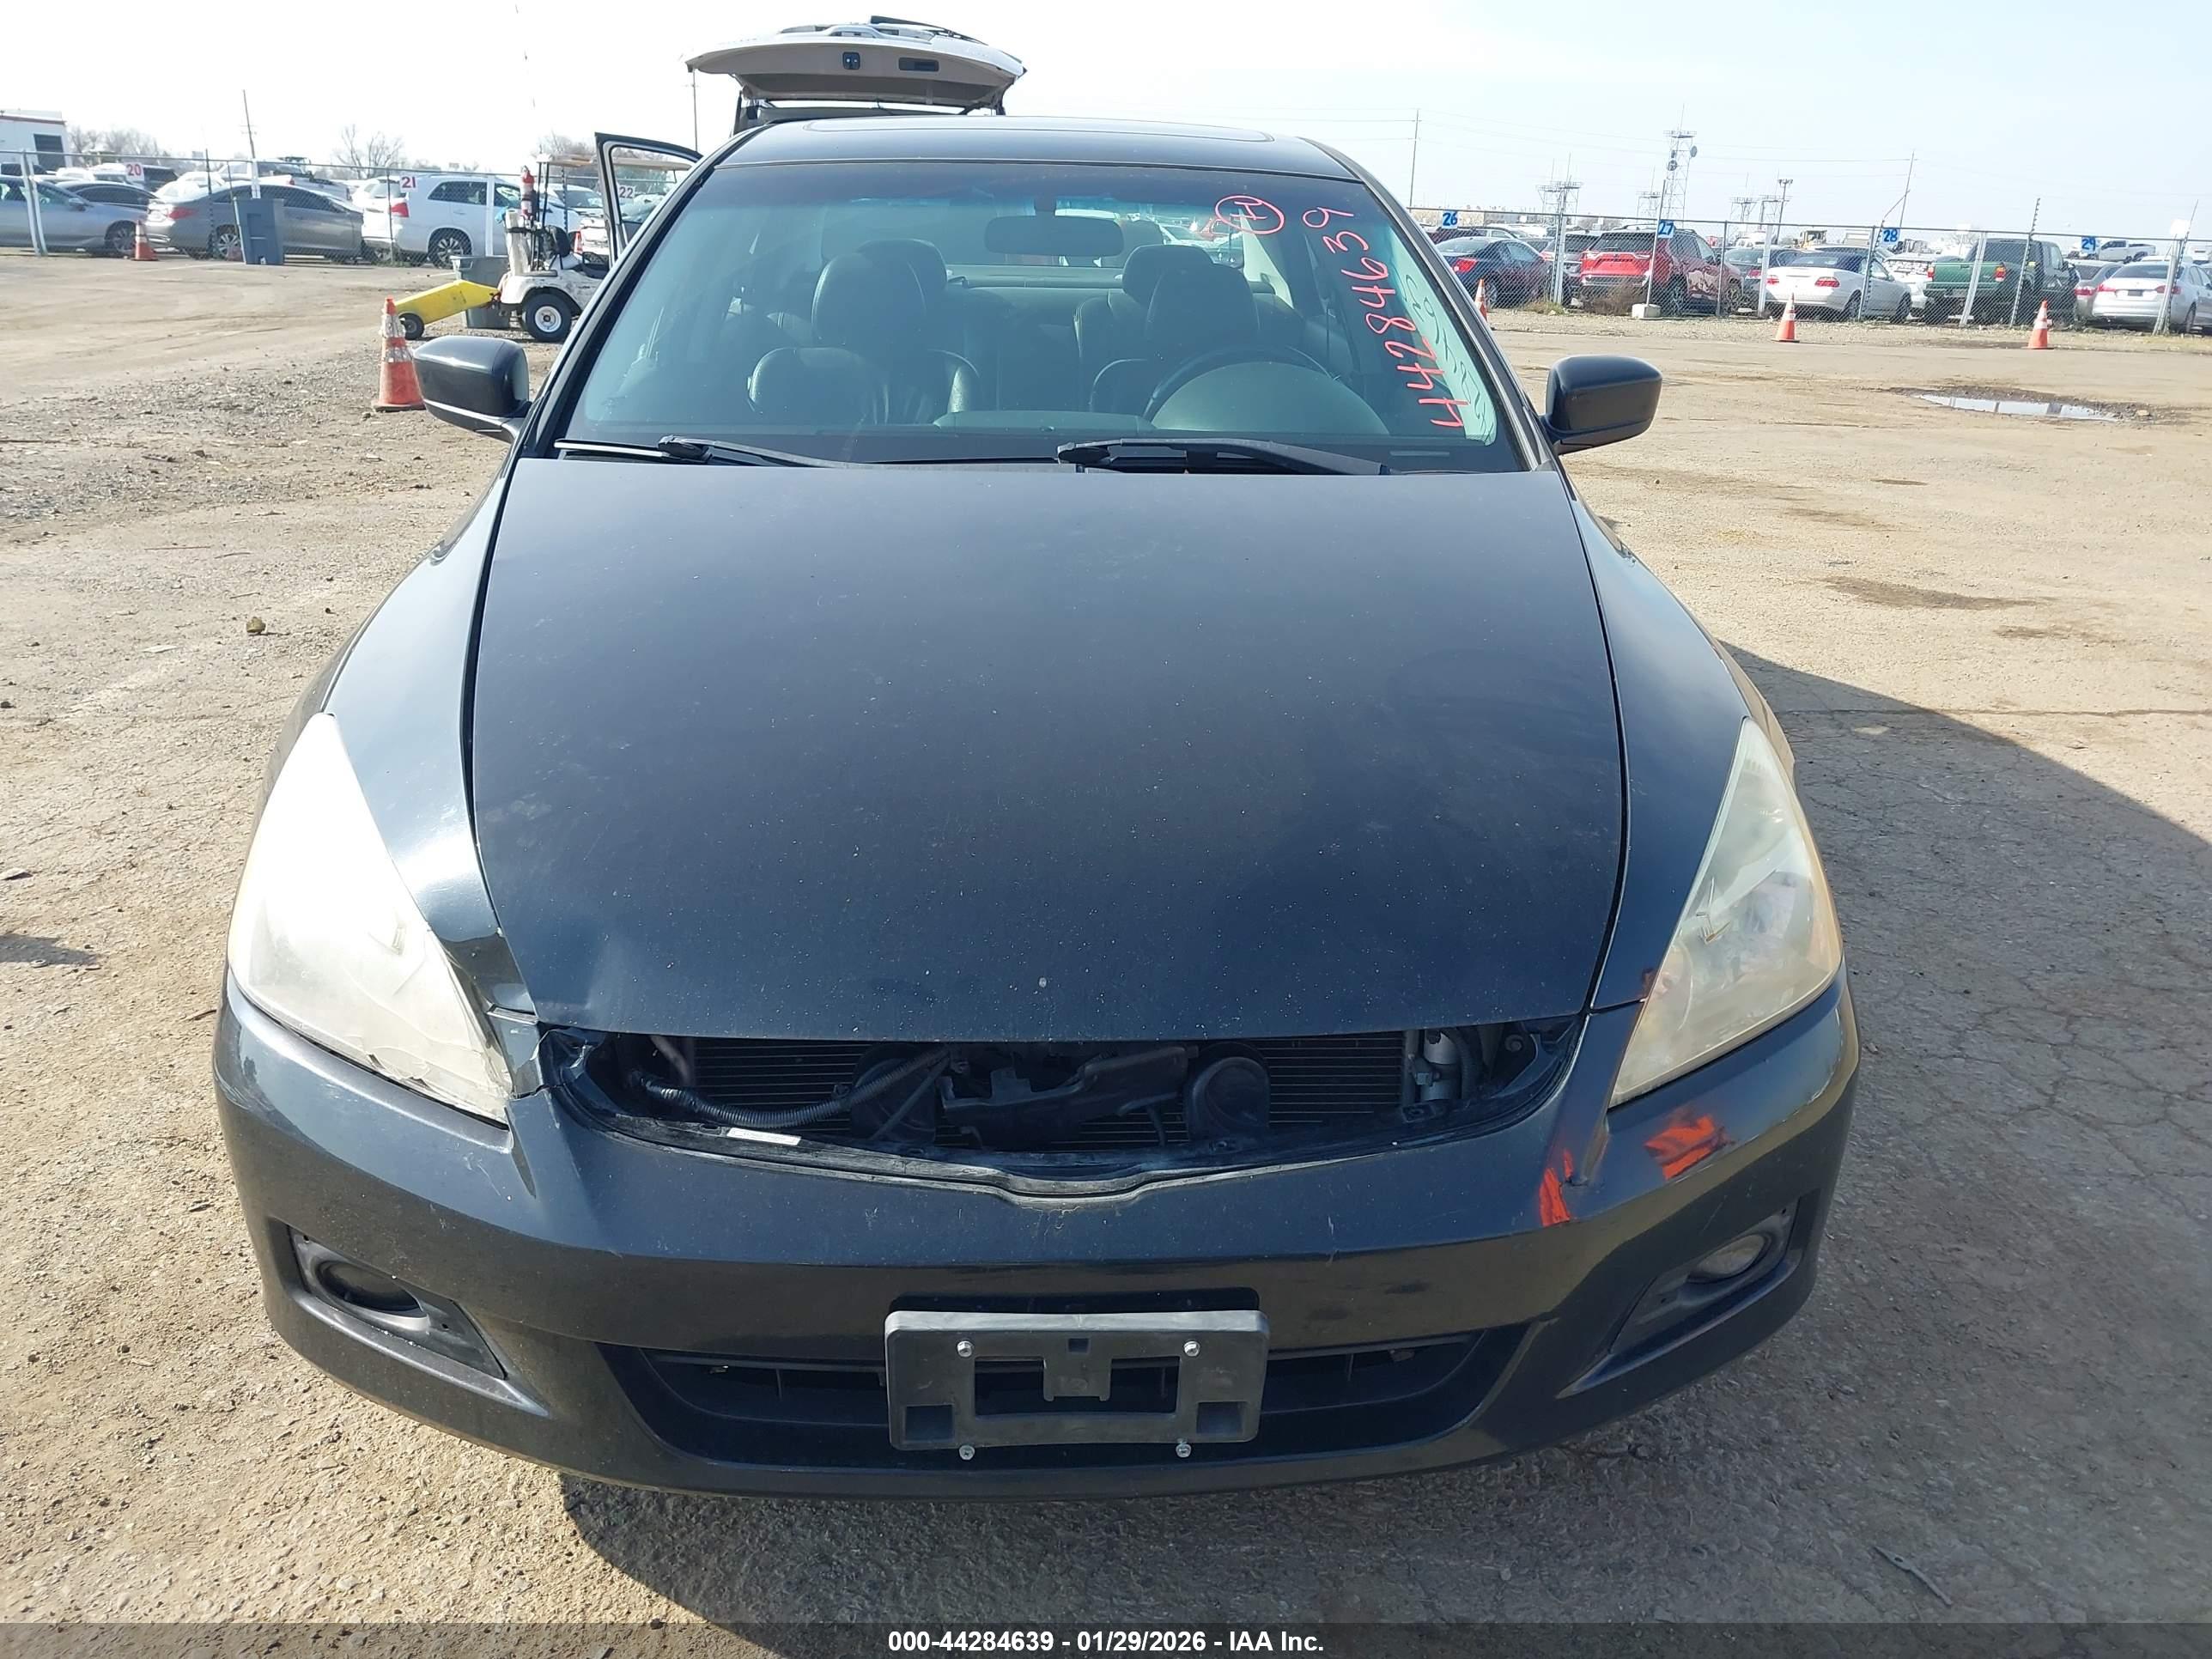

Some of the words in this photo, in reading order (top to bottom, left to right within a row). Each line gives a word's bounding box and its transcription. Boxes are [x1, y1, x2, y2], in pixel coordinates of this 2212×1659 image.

[126, 163, 142, 176] 20
[401, 176, 416, 188] 21
[619, 185, 633, 198] 22
[1443, 211, 1458, 226] 26
[1658, 221, 1674, 235] 27
[1883, 228, 1898, 242] 28
[2081, 237, 2096, 251] 29
[1302, 206, 1470, 428] 44284639
